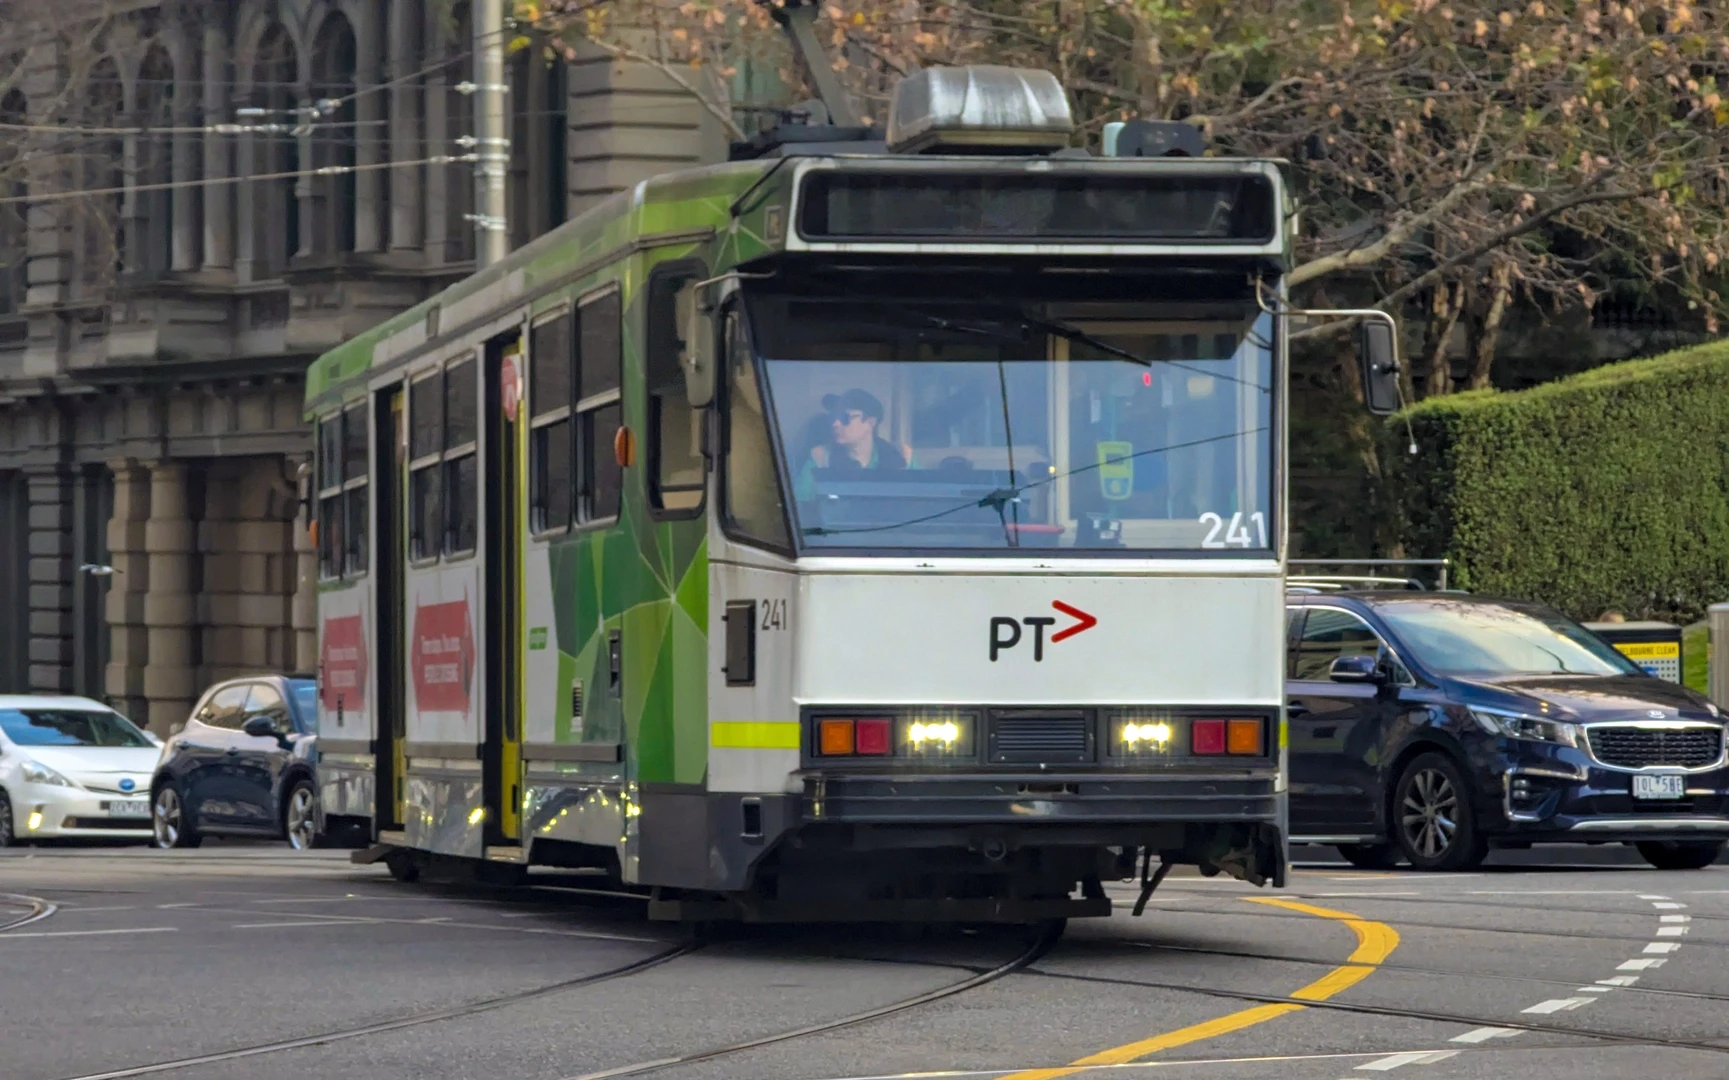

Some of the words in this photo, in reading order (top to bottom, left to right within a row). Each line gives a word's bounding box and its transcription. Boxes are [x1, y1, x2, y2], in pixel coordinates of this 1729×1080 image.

[1199, 511, 1267, 548] 241
[762, 598, 786, 631] 241
[1620, 647, 1654, 656] ELBOURNE
